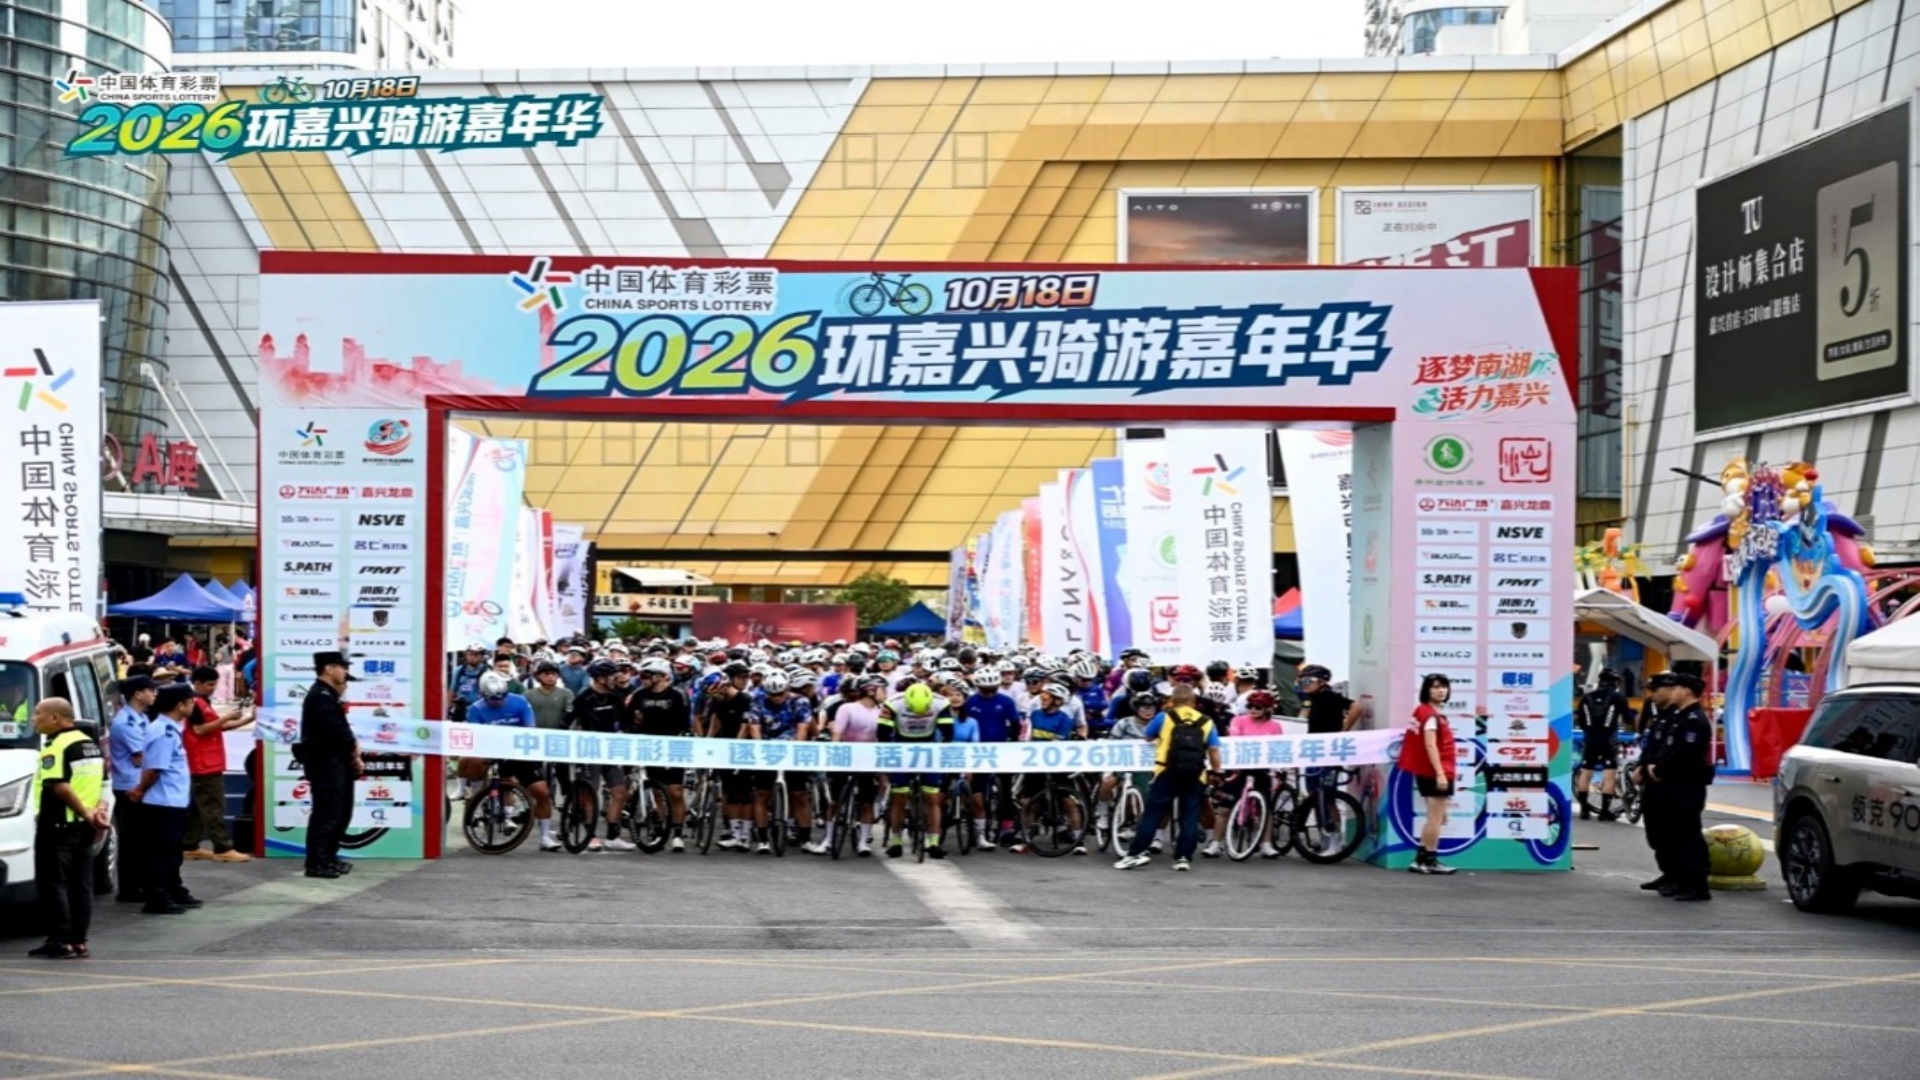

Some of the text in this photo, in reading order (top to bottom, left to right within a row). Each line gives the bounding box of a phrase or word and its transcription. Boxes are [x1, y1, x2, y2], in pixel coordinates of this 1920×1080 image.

[1705, 237, 1805, 299] 设计师集合店
[1839, 193, 1875, 318] 5
[585, 270, 773, 296] 中国体育彩票
[946, 277, 1096, 309] 10月18日
[585, 298, 773, 311] CHINA SPORTS LOTTERY
[1412, 352, 1533, 385] 逐梦南湖
[1438, 382, 1550, 412] 活力嘉兴
[358, 514, 406, 526] NSVE
[1497, 527, 1544, 538] NSVE
[284, 562, 332, 572] S.PATH
[1423, 574, 1471, 584] S.PATH
[875, 744, 997, 768] 活力嘉兴
